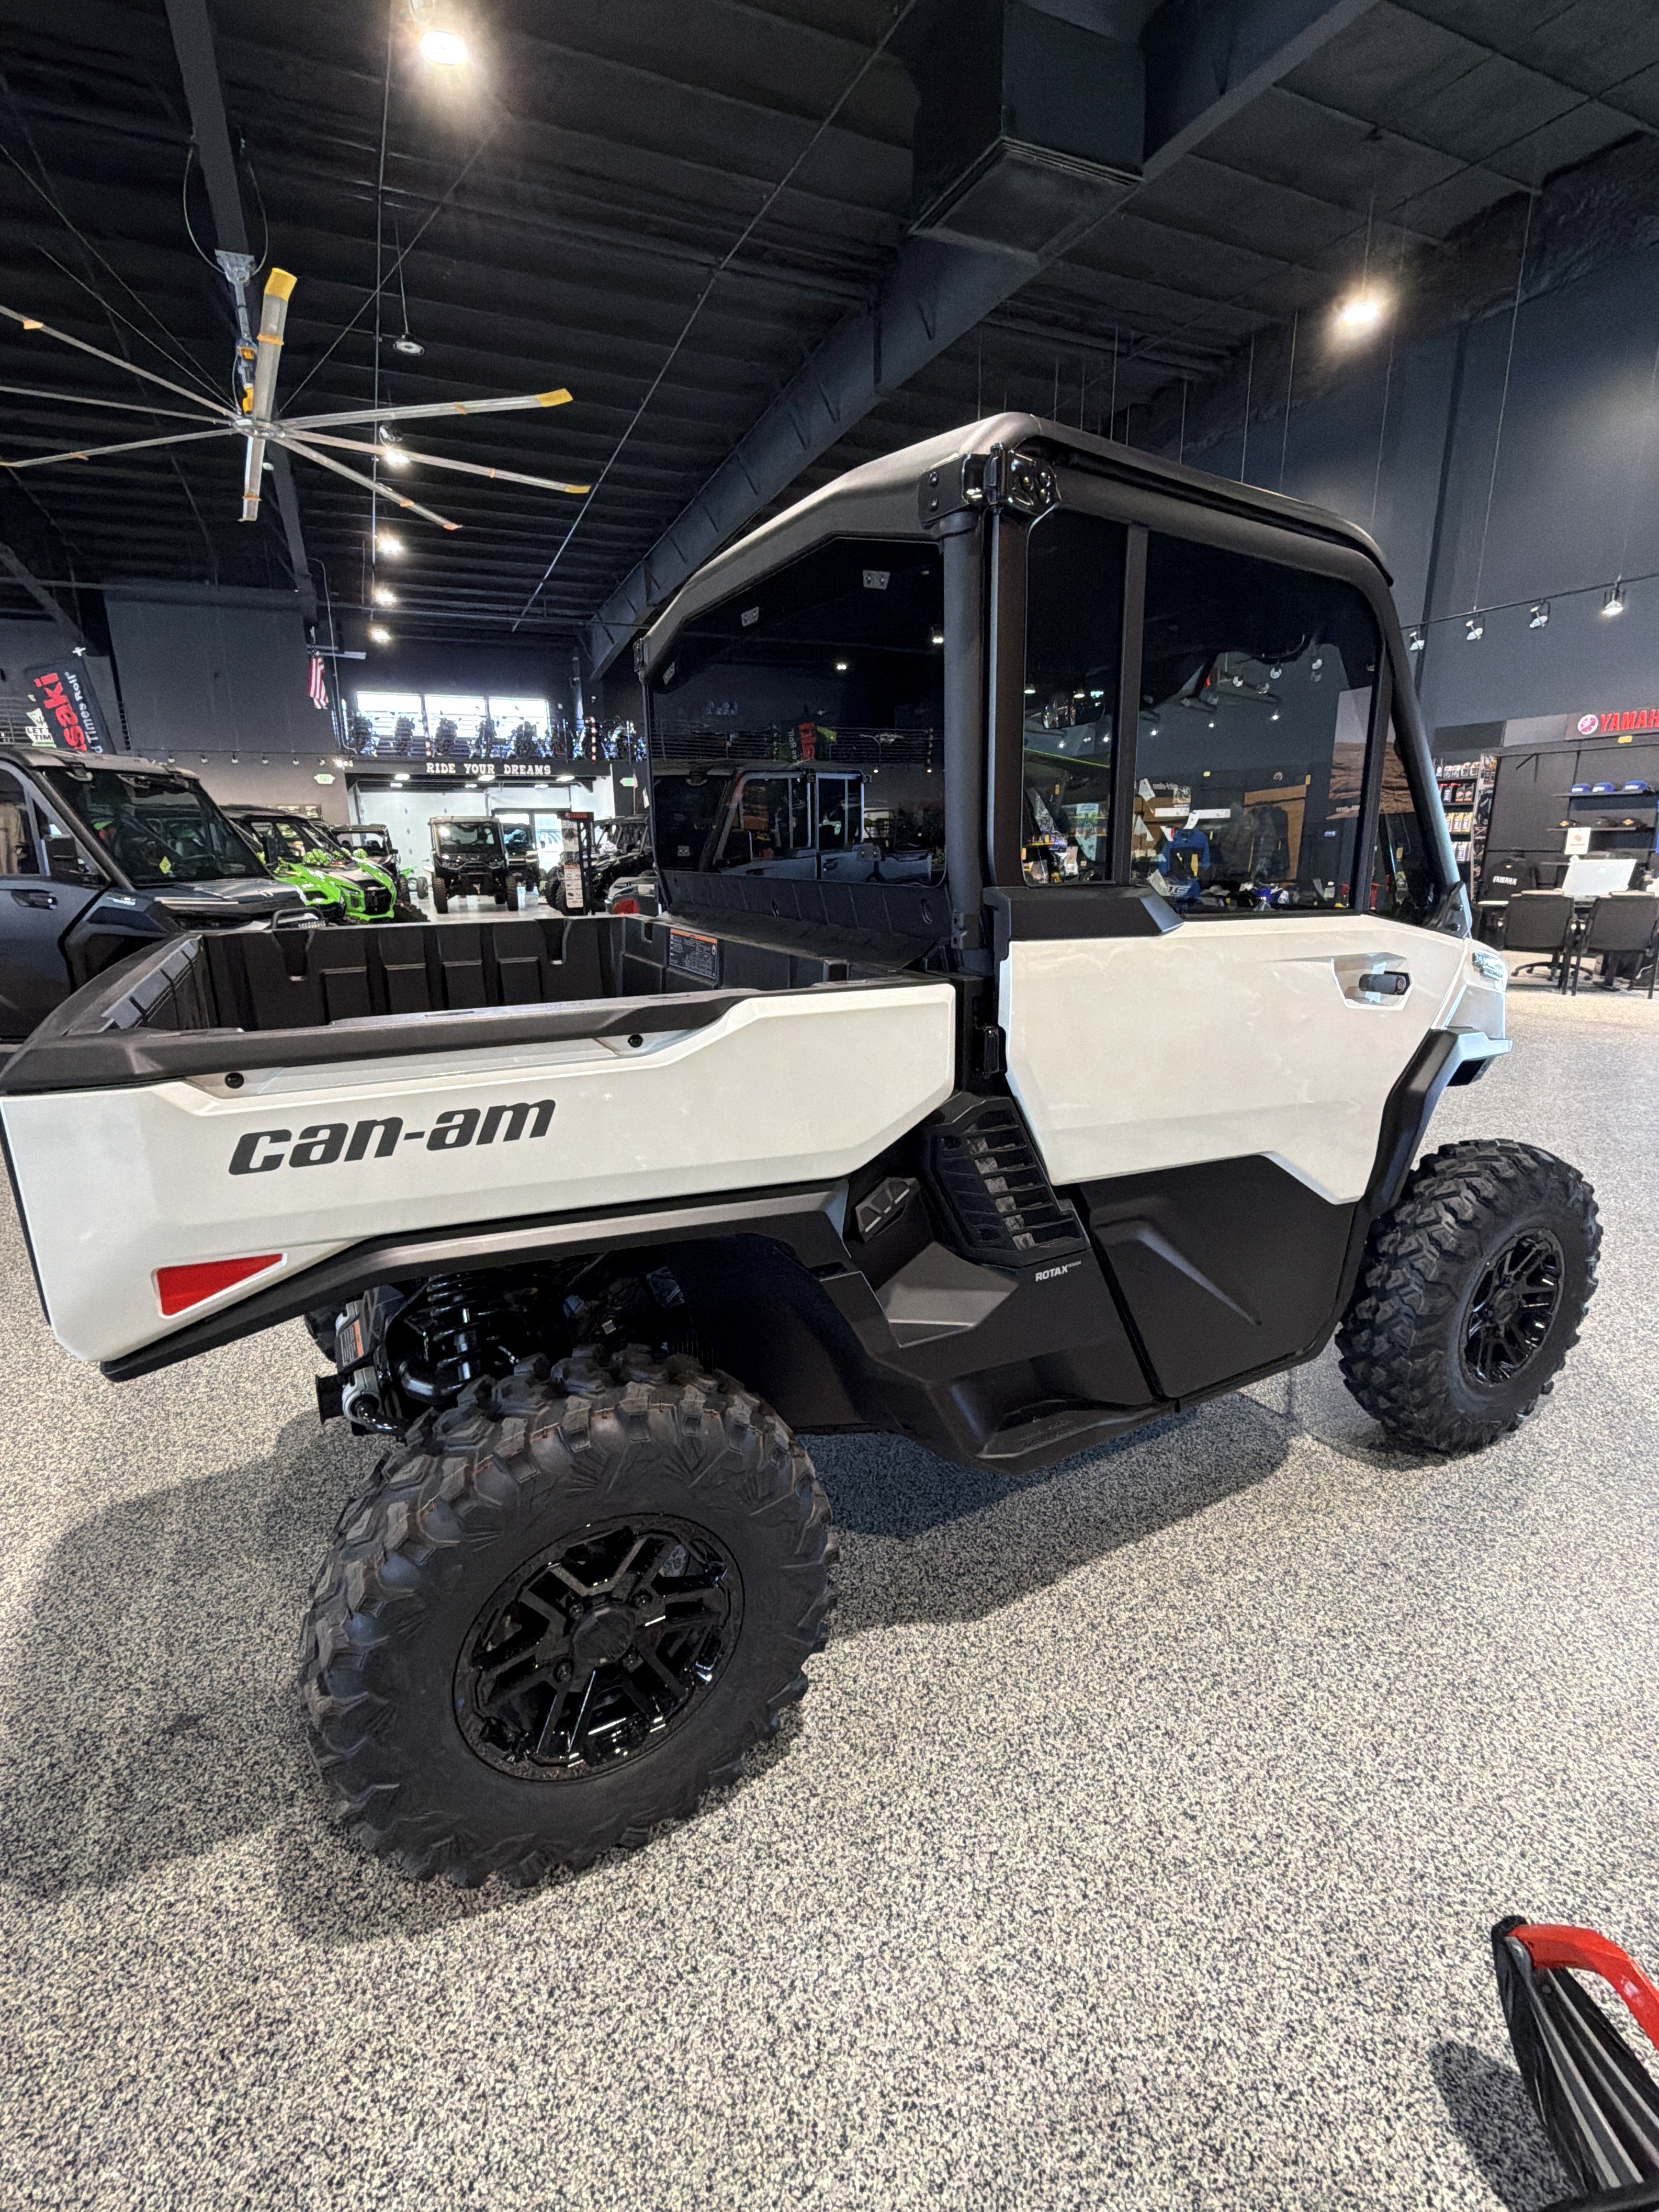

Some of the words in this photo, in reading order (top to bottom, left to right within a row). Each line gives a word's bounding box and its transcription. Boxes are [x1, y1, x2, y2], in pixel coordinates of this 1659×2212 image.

[78, 702, 99, 744] Times
[426, 763, 456, 774] RIDE
[464, 763, 495, 774] YOUR
[504, 764, 551, 775] DREAMS
[228, 1099, 556, 1175] can-am
[1035, 1264, 1068, 1282] ROTAX
